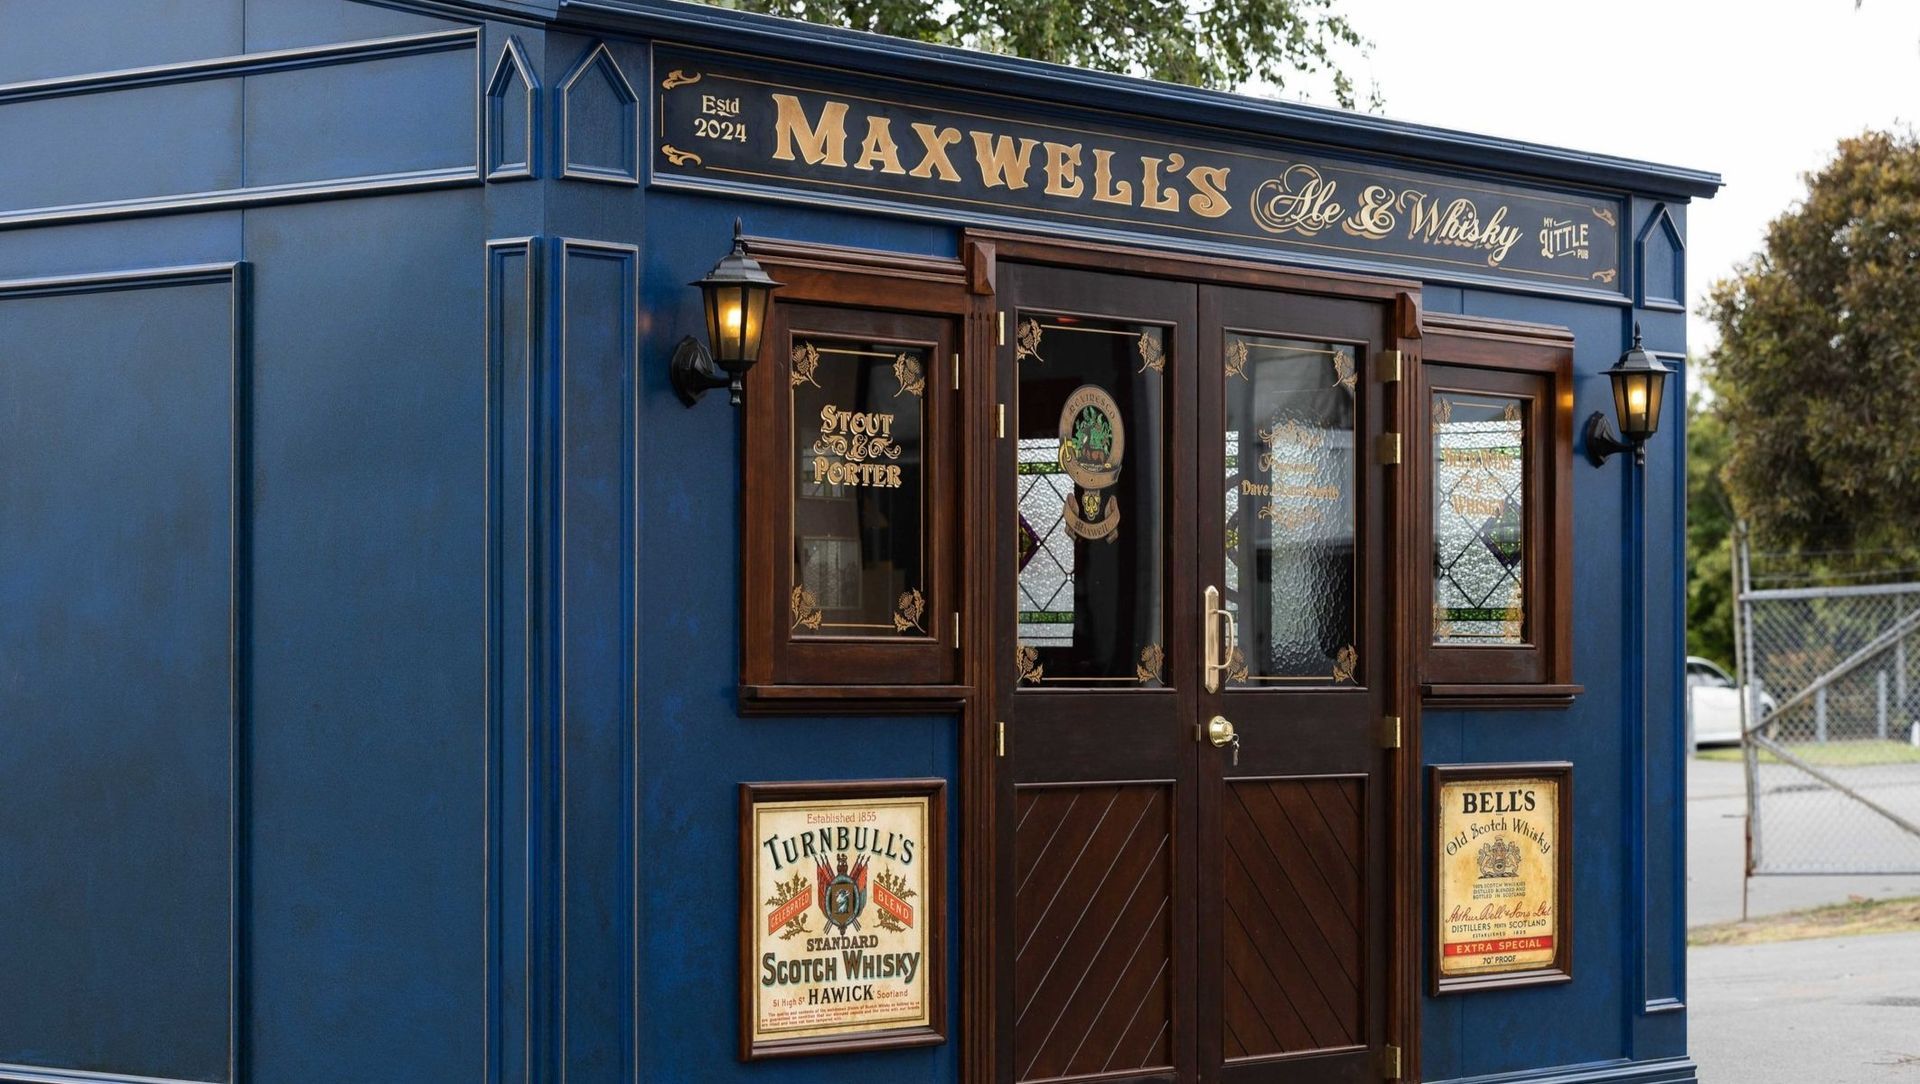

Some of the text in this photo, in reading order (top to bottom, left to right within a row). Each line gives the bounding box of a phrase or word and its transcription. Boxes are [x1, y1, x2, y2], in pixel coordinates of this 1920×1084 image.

[701, 94, 740, 118] Estd
[693, 117, 748, 143] 2024
[771, 92, 1233, 218] MAXWELL'S
[1250, 163, 1524, 267] Ale & Whisky
[1543, 216, 1554, 228] MY
[1539, 223, 1589, 259] LITTLE
[1577, 248, 1589, 259] PUB
[1241, 480, 1269, 497] Dave
[1462, 788, 1536, 814] BELL'S
[807, 811, 877, 825] Established 1855
[763, 826, 915, 871] TURNBULL'S
[1446, 817, 1551, 856] Old Scotch Whisky
[878, 890, 910, 920] BLEND
[1452, 922, 1491, 934] DISTILLERS
[1509, 918, 1547, 929] SCOTLAND
[806, 934, 879, 952] STANDARD
[1456, 938, 1542, 954] EXTRA SPECIAL
[1495, 954, 1517, 964] PROOF
[781, 998, 797, 1009] High
[808, 984, 875, 1006] HAWICK
[876, 989, 909, 999] Scotland
